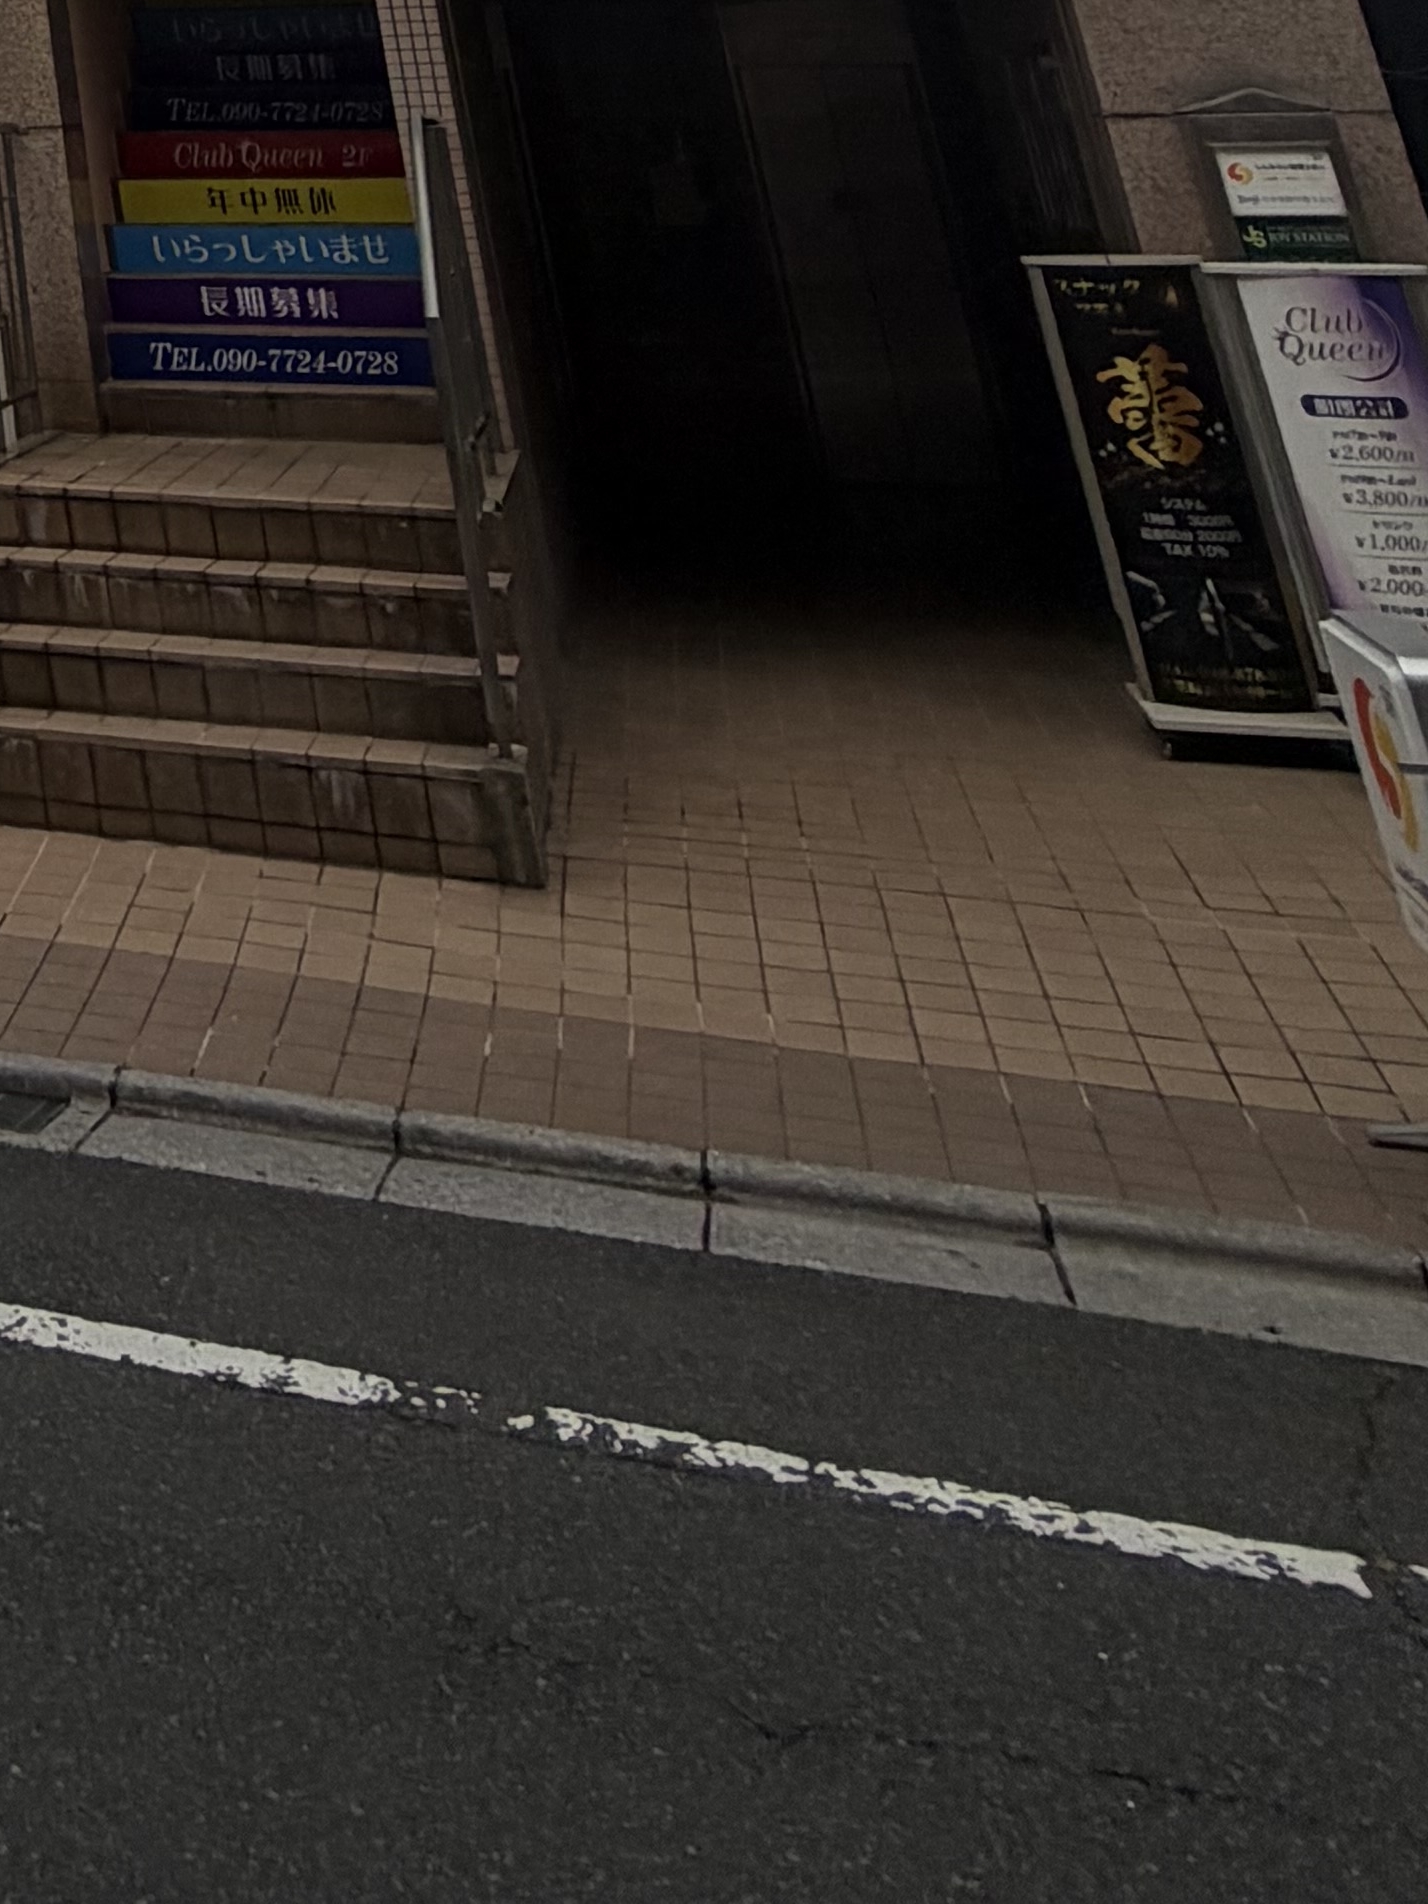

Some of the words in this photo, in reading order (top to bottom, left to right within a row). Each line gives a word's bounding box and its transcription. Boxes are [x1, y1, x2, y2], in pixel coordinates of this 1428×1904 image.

[174, 141, 234, 170] Club
[238, 141, 325, 172] Queen
[206, 186, 337, 217] 年中無休
[152, 233, 390, 265] いらっしゃいませ
[200, 286, 340, 321] 長期募集
[1285, 305, 1364, 334] Club
[149, 341, 399, 376] TEL.090-7724-0728
[1278, 333, 1388, 366] Queen
